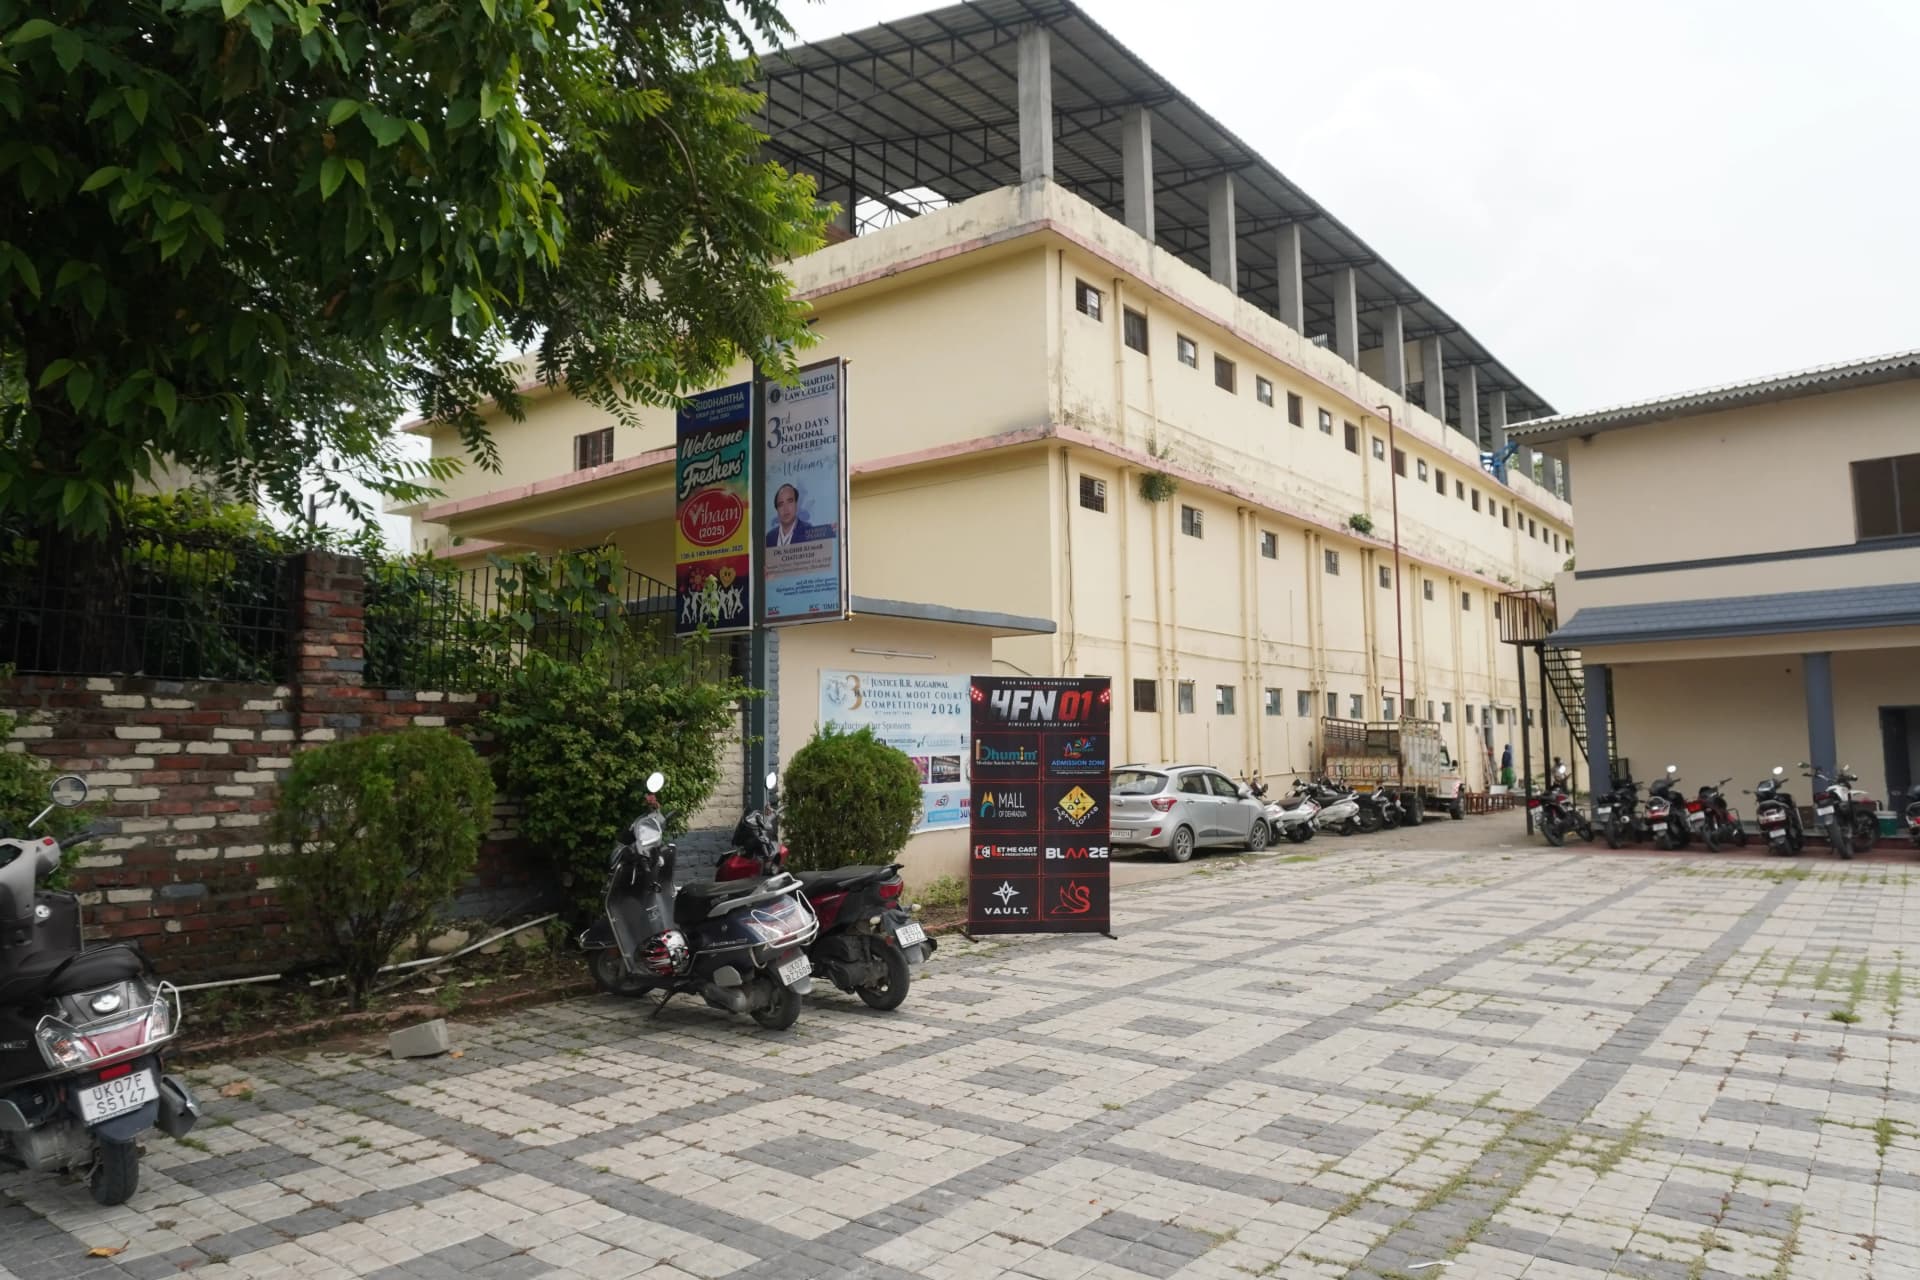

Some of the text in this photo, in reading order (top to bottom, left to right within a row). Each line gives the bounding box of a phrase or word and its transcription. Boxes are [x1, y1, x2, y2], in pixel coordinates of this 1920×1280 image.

[696, 391, 745, 411] SIDDHARTHA
[785, 383, 836, 401] LAW COLLEGE
[781, 416, 829, 434] TWO DAYS
[681, 429, 743, 460] Welcome
[781, 428, 825, 444] NATIONAL
[781, 434, 837, 454] CONFERENCE
[699, 525, 725, 540] (2025)
[872, 678, 897, 688] JUSTICE
[854, 689, 963, 700] NATIONAL MOOT COURT
[864, 700, 961, 715] COMPETITION 2026
[1058, 690, 1093, 721] 01
[998, 792, 1025, 808] MALL
[1045, 847, 1109, 859] BLAAZE
[92, 1073, 143, 1101] UK07F
[97, 1087, 146, 1115] S5147
